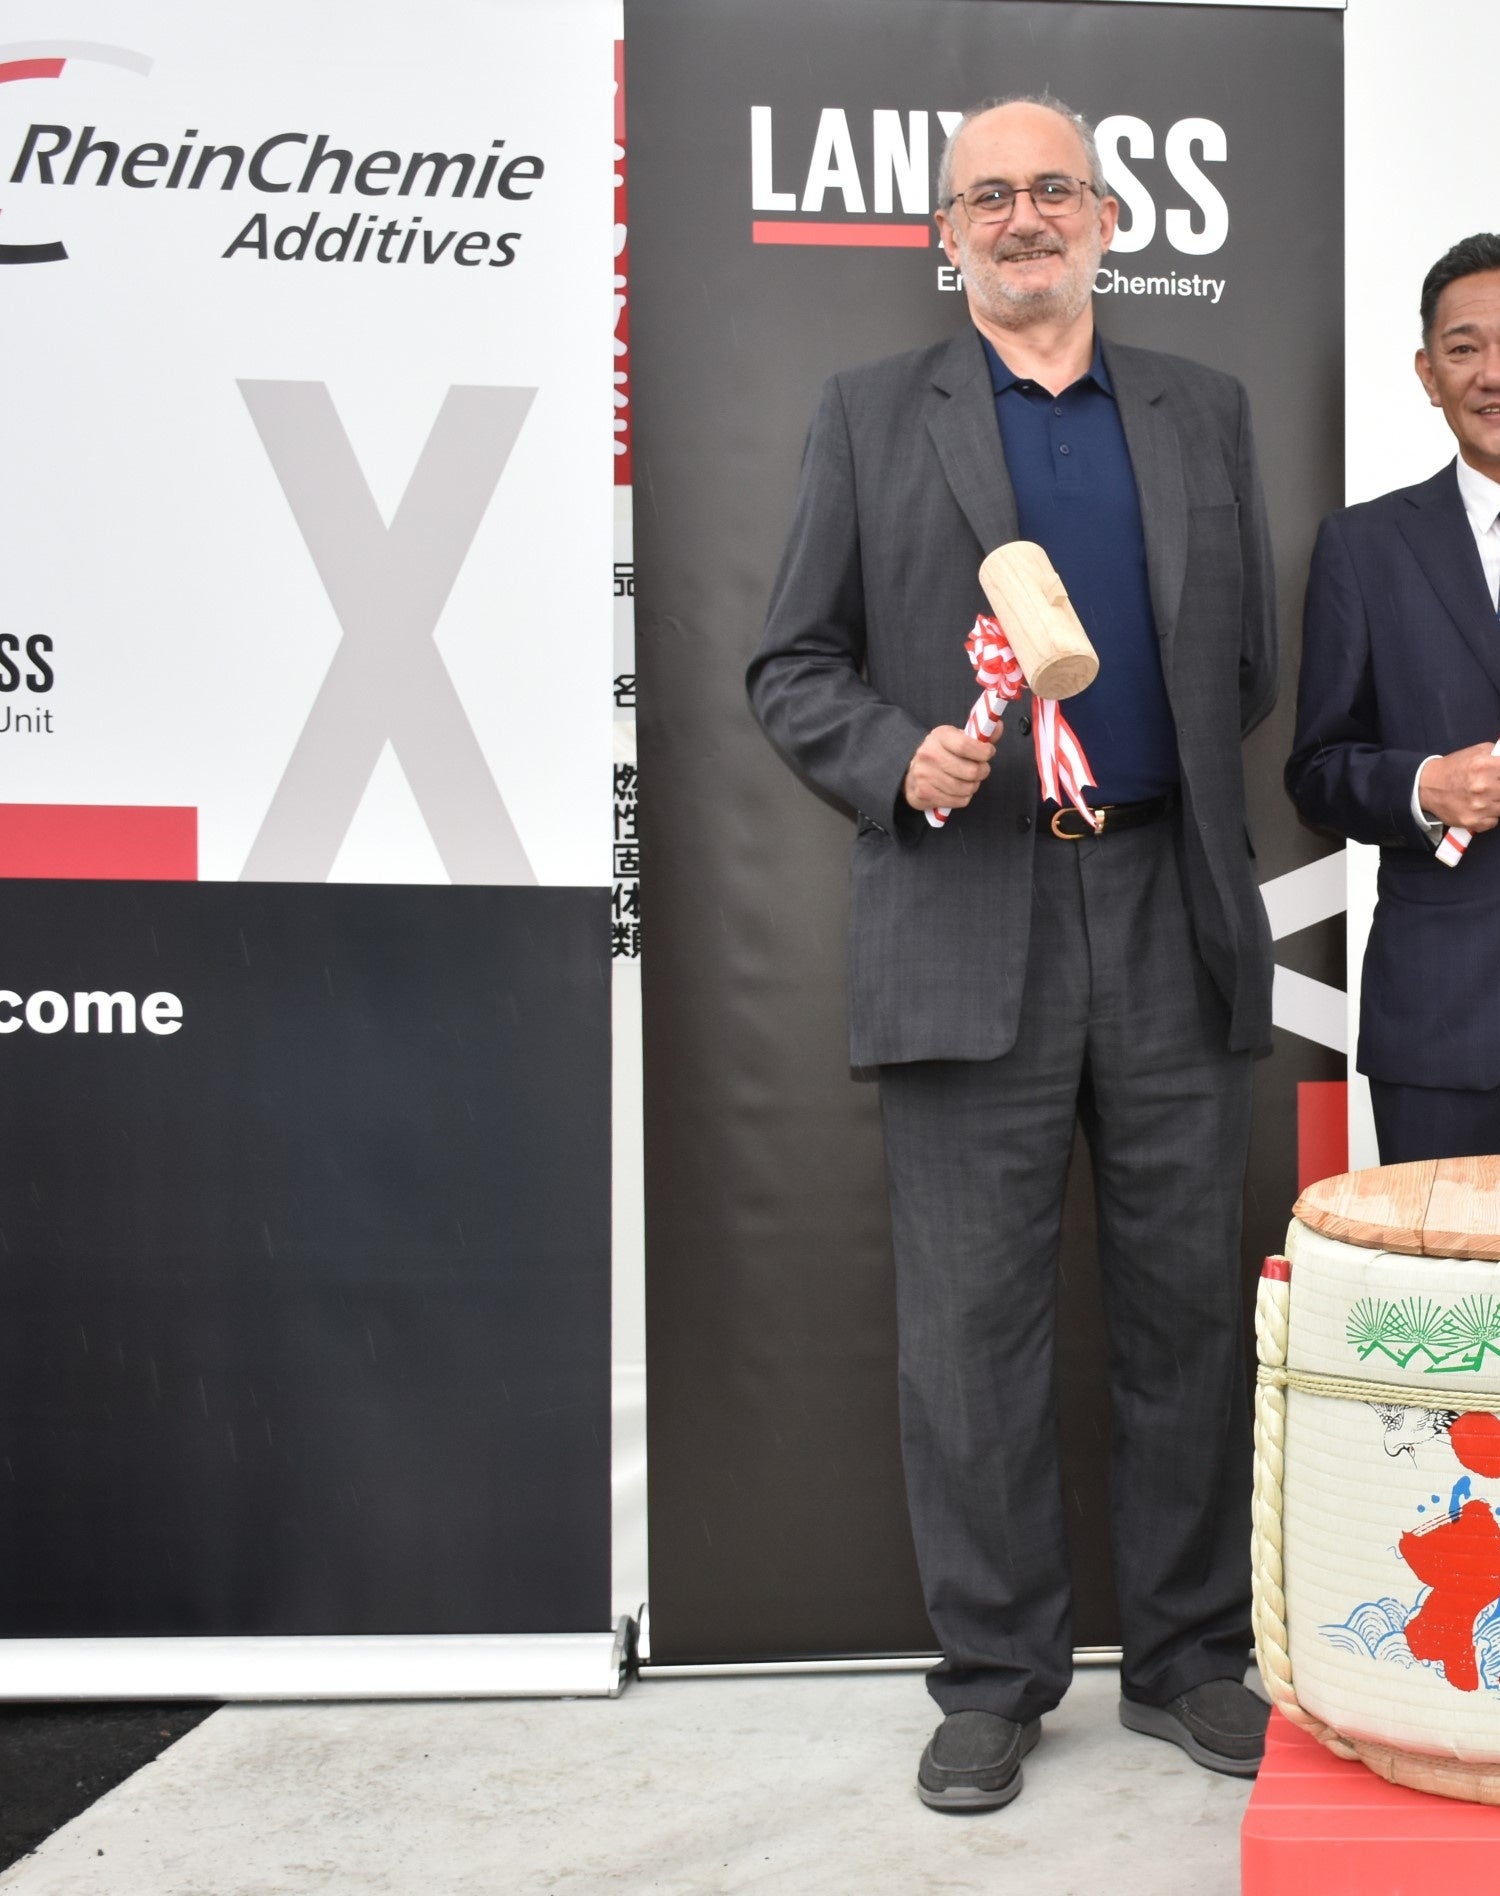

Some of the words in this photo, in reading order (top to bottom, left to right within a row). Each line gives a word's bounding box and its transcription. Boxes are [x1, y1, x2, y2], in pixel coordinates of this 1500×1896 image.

[10, 123, 545, 201] RheinChemie
[750, 105, 1229, 256] LANSS
[221, 211, 522, 268] Additives
[1092, 268, 1226, 304] Chemistry
